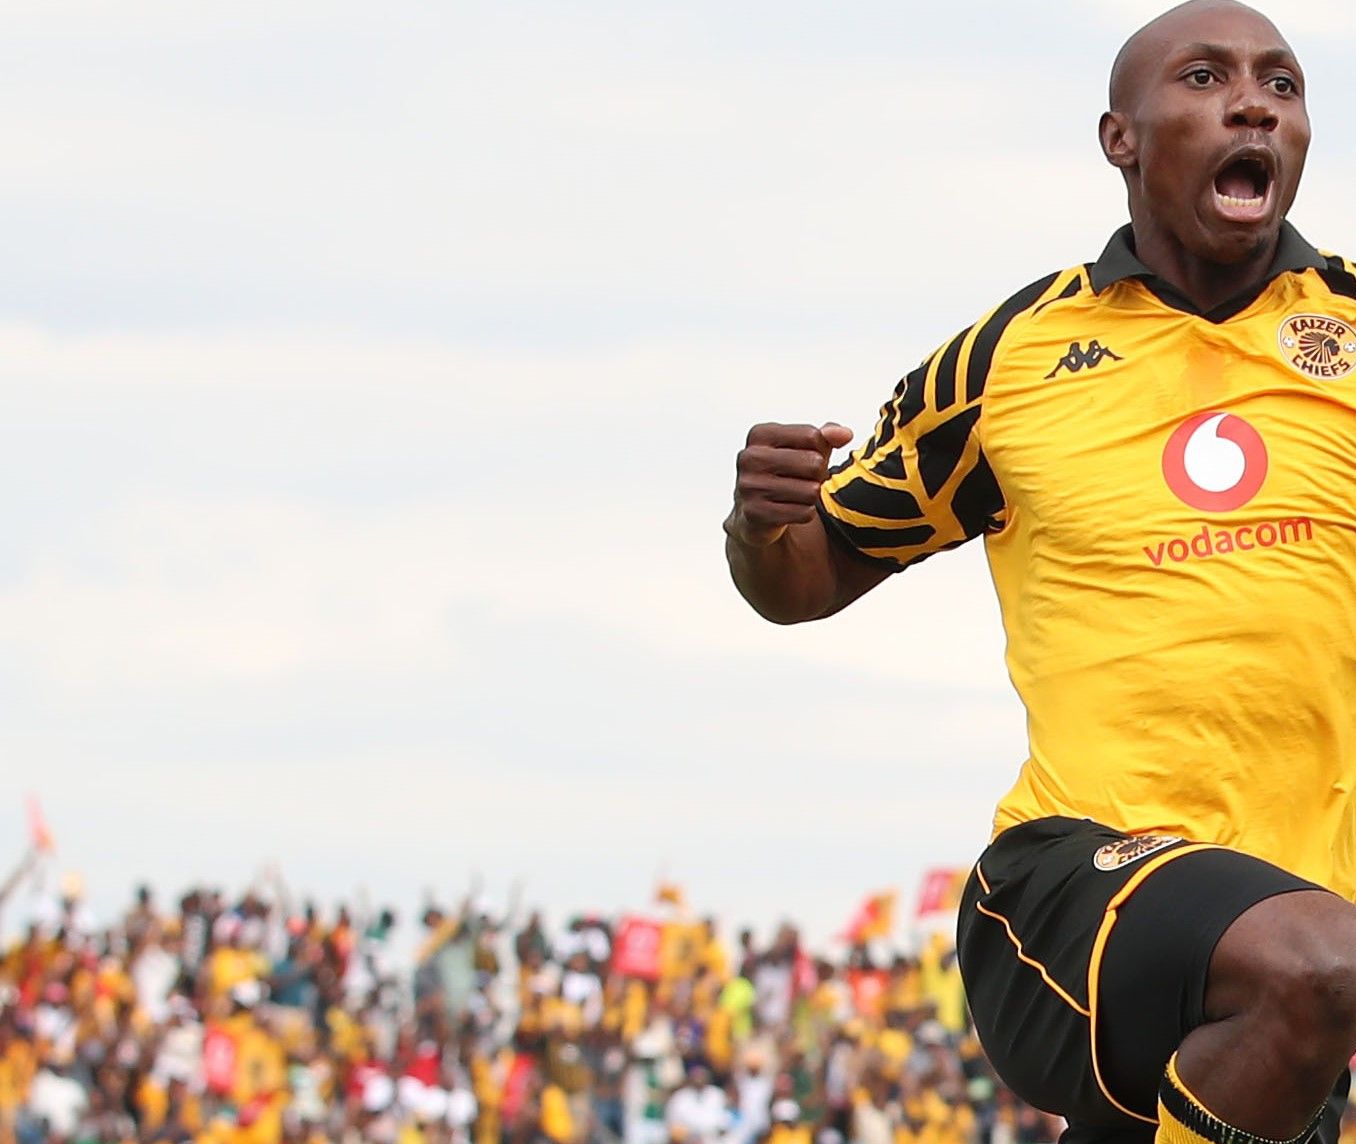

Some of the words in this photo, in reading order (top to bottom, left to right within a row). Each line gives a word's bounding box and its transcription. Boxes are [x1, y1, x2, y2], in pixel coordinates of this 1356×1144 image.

[1289, 318, 1346, 339] KAIZER
[1291, 353, 1351, 377] CHIEFS
[1142, 517, 1313, 568] vodacom
